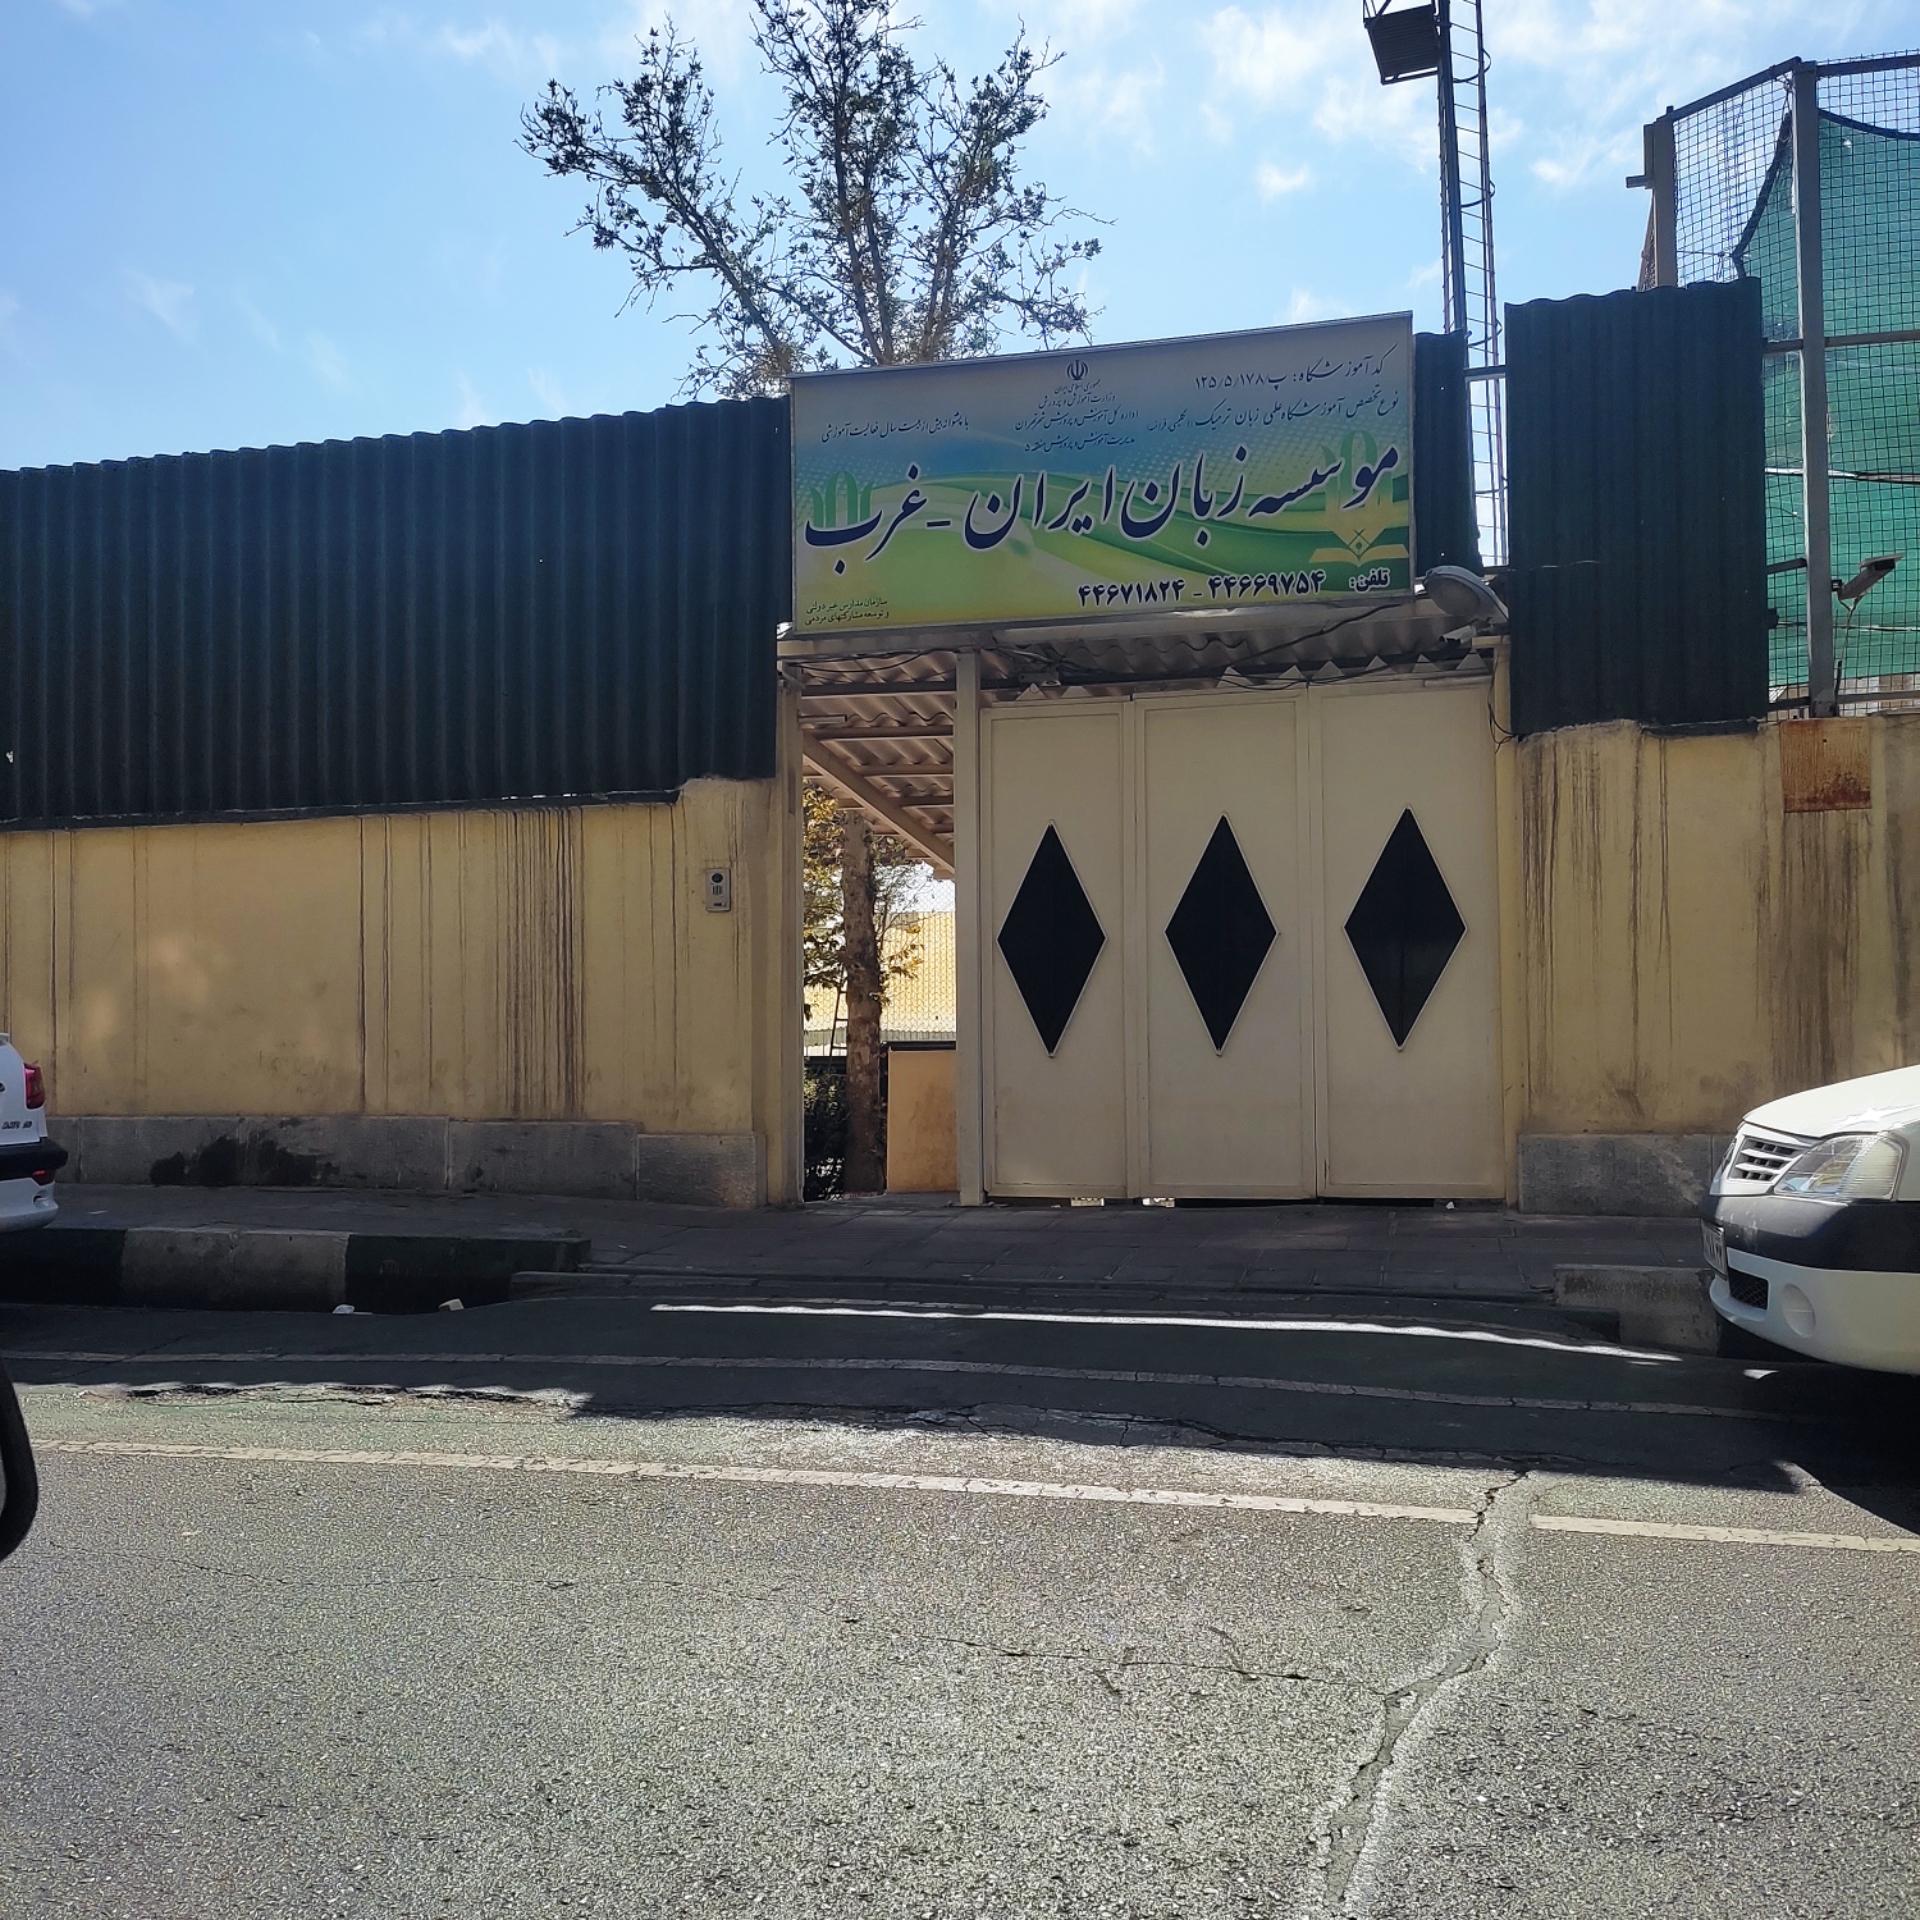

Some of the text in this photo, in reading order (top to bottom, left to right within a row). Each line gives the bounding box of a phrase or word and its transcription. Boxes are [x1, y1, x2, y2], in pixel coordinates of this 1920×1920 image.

[1371, 343, 1398, 376] کد
[1281, 396, 1345, 421] آموزشگاه
[1346, 384, 1382, 418] تخصص
[1377, 390, 1399, 416] نوع
[849, 421, 879, 437] فعالیت
[1235, 407, 1260, 427] زبان
[964, 464, 1114, 551] ایران
[1119, 444, 1248, 547] زبان
[804, 462, 928, 576] غرب
[1078, 578, 1186, 606] ۴۴۶۷۱۸۲۴
[1207, 570, 1327, 599] ۴۴۶۶۹۷۵۴
